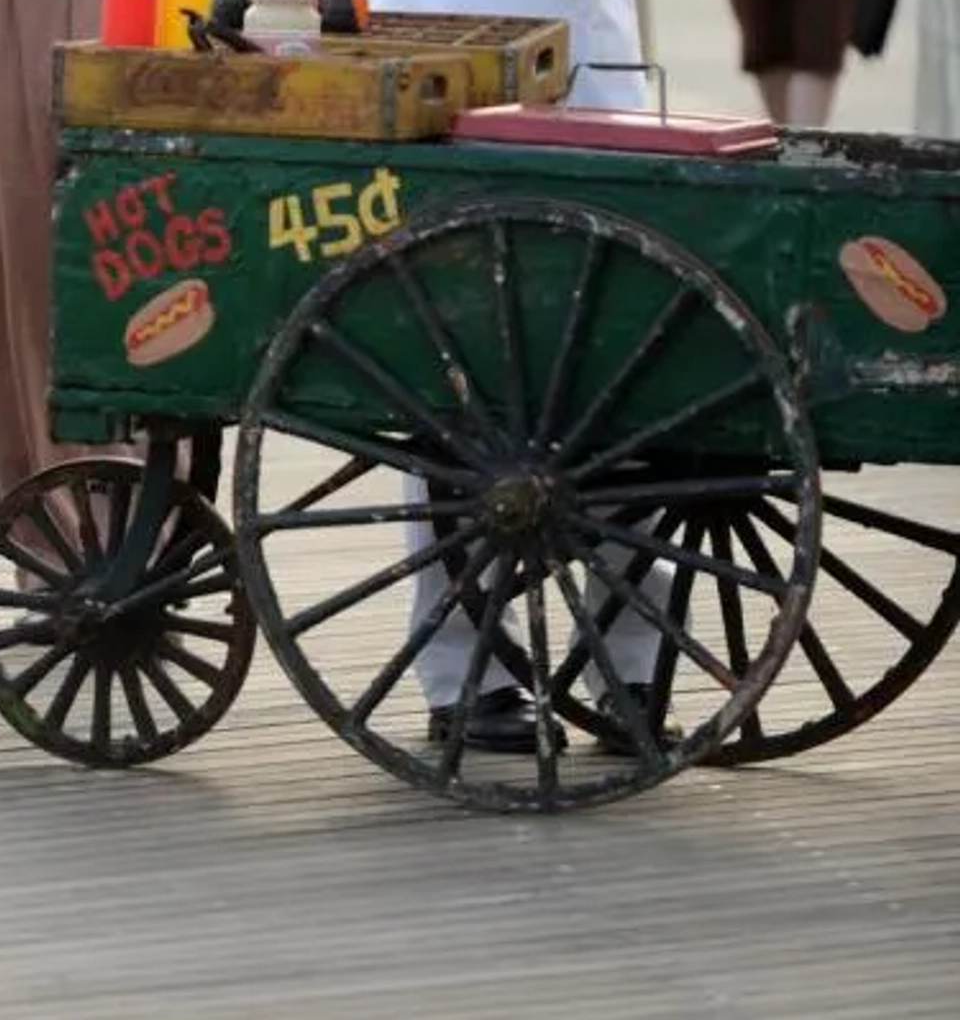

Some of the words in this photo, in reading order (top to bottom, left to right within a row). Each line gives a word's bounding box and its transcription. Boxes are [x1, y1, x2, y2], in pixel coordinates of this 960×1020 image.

[83, 168, 177, 244] HOT
[268, 166, 402, 263] 45¢
[93, 207, 231, 303] DOGS
